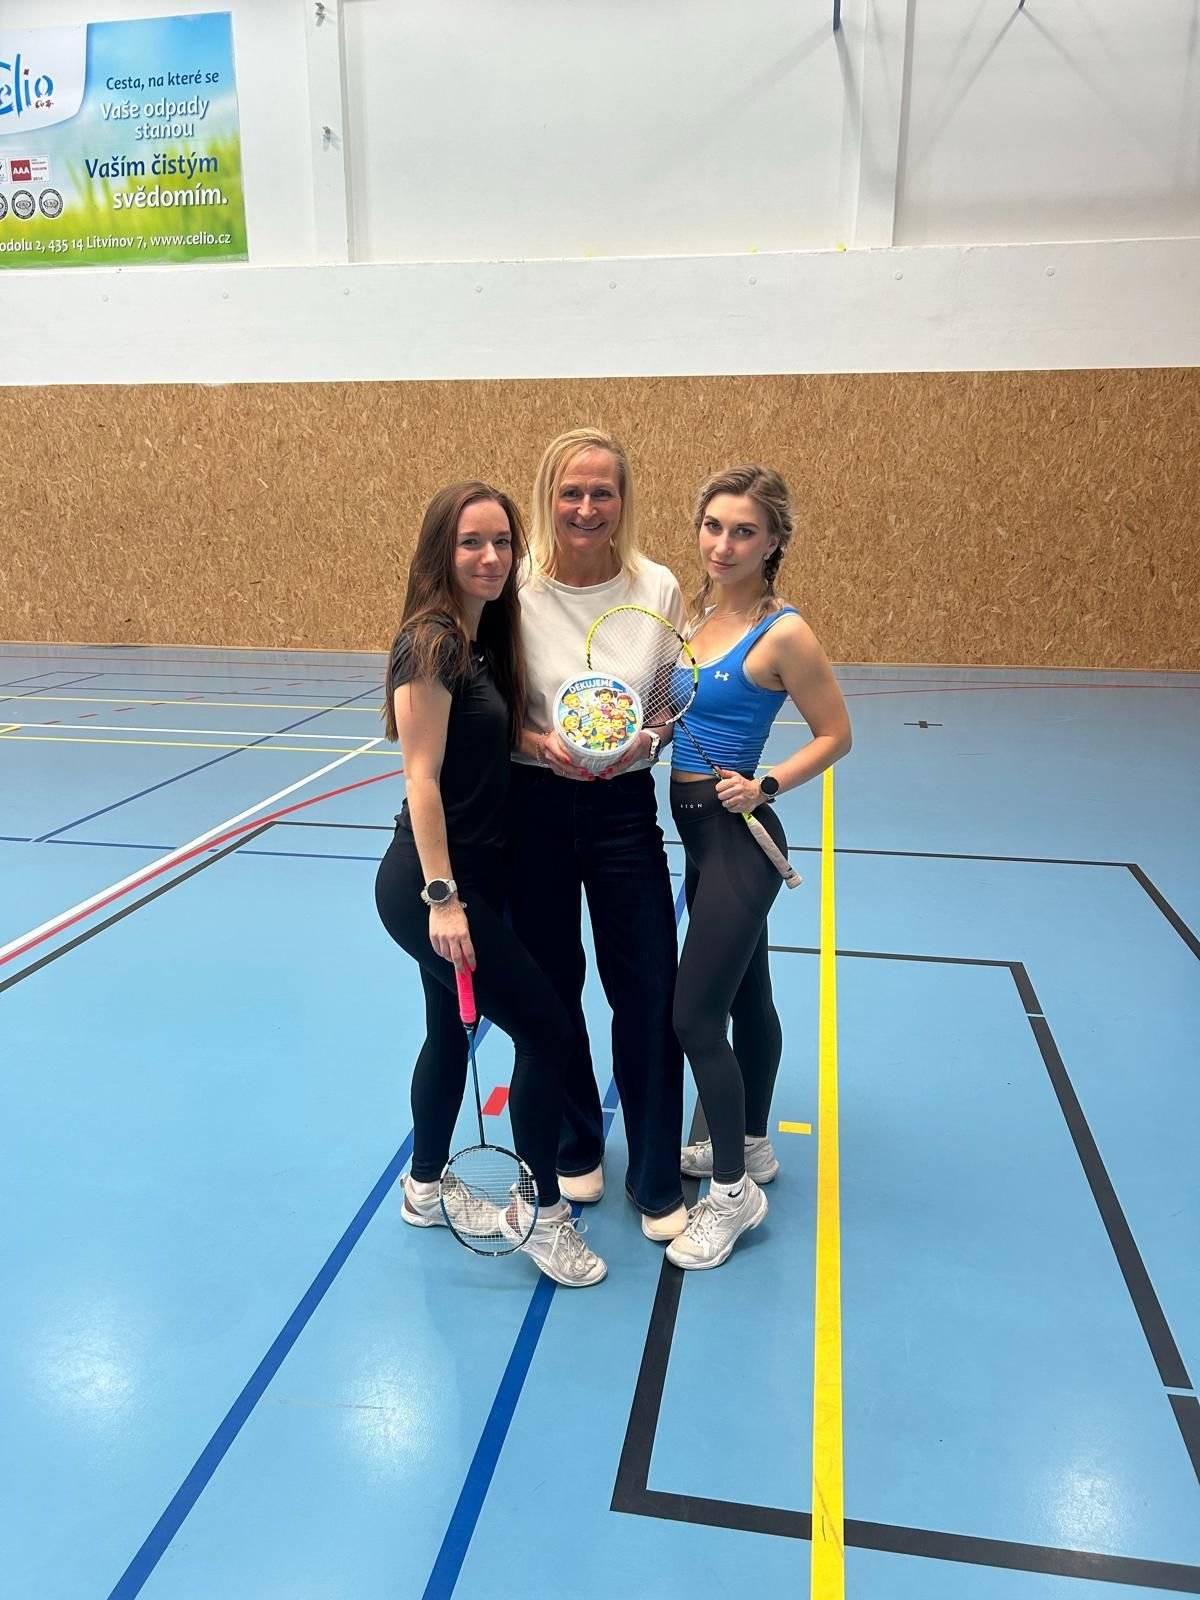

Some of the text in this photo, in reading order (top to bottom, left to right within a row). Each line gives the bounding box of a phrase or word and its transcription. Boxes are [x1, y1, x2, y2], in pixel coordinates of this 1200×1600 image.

[106, 70, 220, 92] Cesta, na které se
[100, 95, 210, 121] Vaše odpady
[135, 123, 195, 141] stanou
[13, 167, 30, 175] AAA
[85, 152, 218, 179] Vaším čistým
[112, 183, 229, 209] svědomím.
[34, 240, 45, 253] 2,
[48, 239, 68, 253] 435
[71, 239, 83, 251] 14
[86, 235, 134, 249] Litvínov
[136, 236, 147, 249] 7,
[150, 231, 231, 246] www.celio.cz
